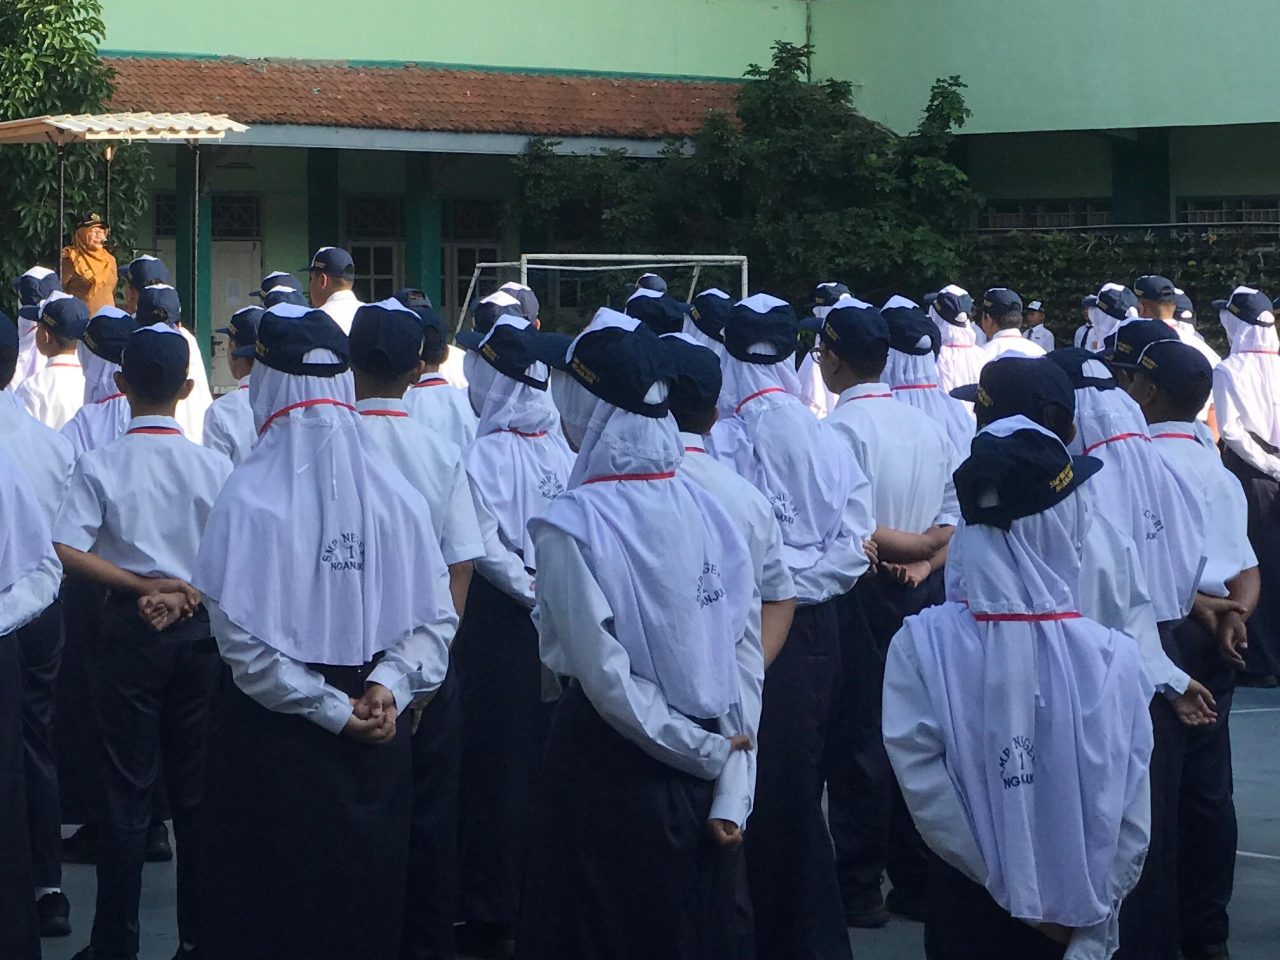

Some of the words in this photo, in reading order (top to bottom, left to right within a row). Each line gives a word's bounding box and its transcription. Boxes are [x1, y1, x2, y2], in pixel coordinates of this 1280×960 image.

[322, 539, 338, 563] SMP
[346, 545, 354, 559] 1
[1020, 752, 1025, 770] 1
